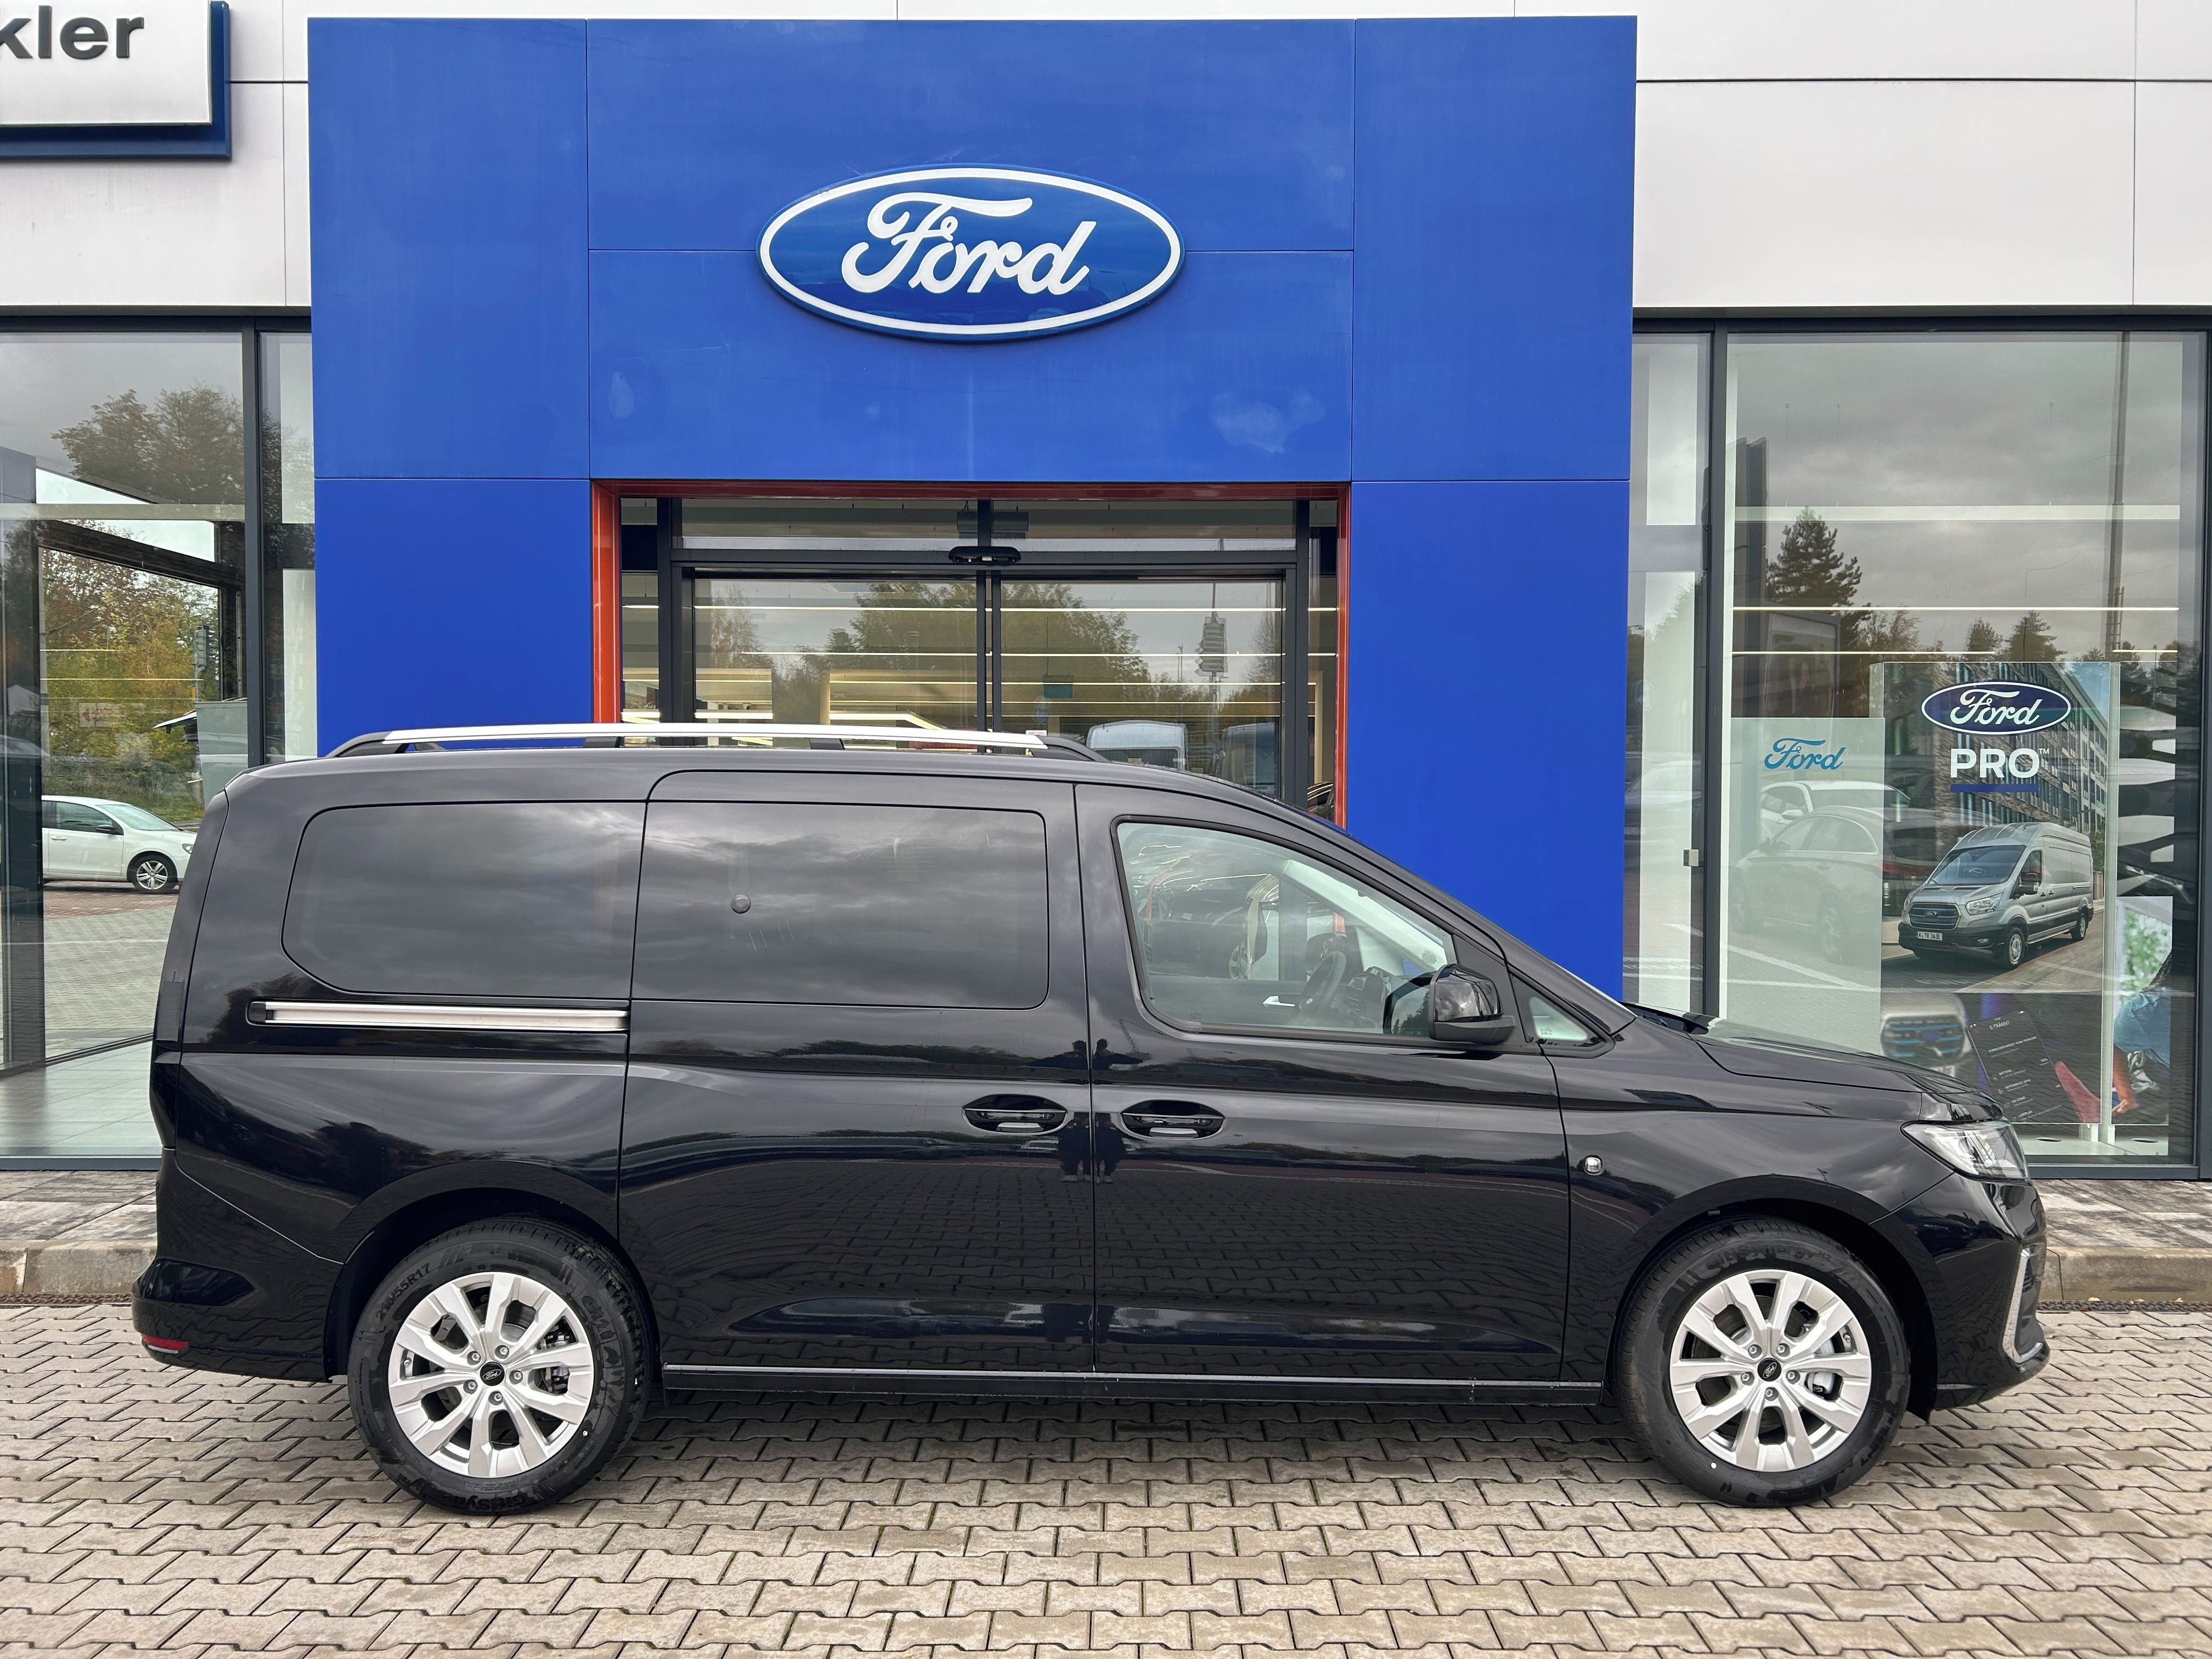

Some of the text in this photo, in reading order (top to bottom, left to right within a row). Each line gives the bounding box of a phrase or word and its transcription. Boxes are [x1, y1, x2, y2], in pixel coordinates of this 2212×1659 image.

[0, 5, 144, 60] kler
[841, 192, 1097, 295] Ford
[1950, 689, 2042, 725] Ford
[1764, 738, 1846, 770] Ford
[1950, 748, 2039, 778] PRO
